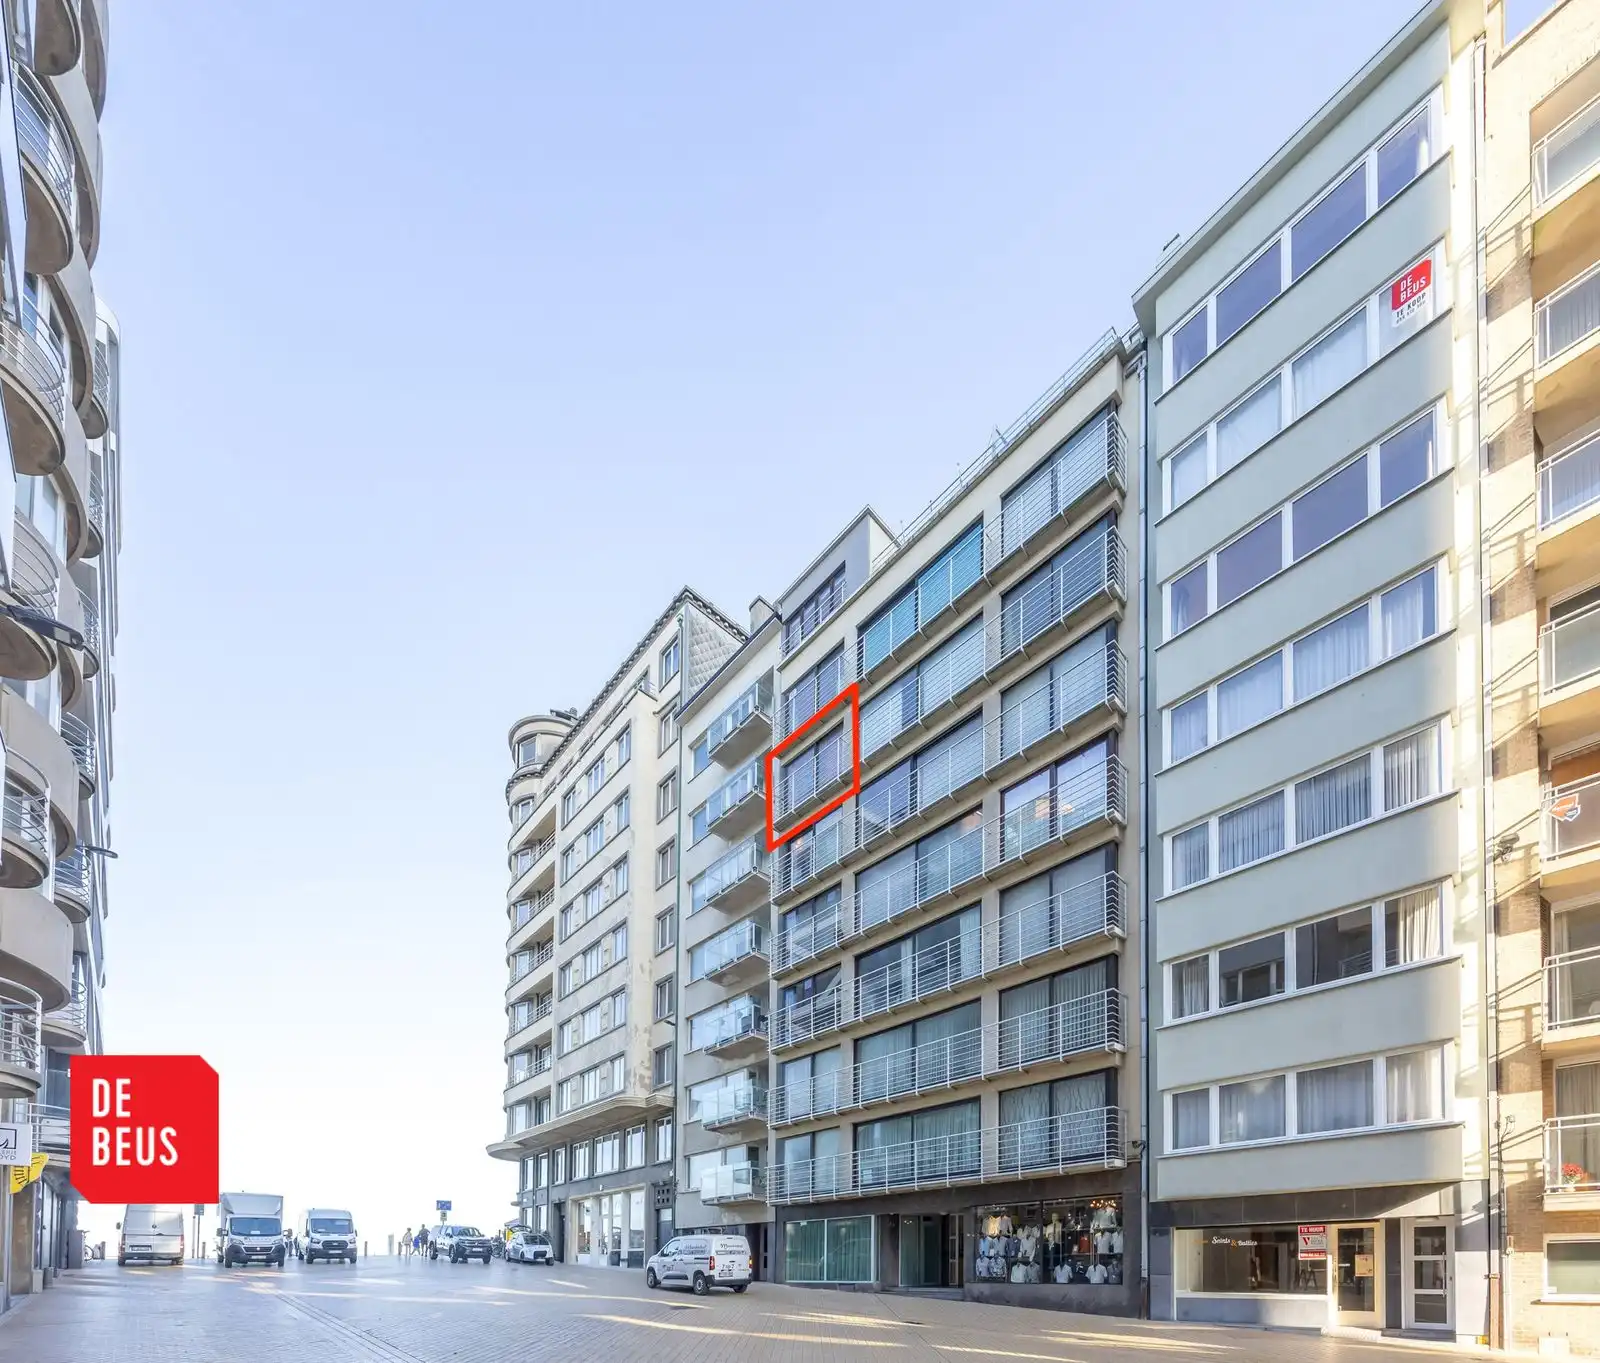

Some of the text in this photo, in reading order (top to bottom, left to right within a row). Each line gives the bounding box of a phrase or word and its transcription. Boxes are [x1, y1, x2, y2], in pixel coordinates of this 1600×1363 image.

[1400, 275, 1412, 291] DE
[1400, 276, 1426, 302] BEUS
[1396, 308, 1403, 317] TE
[1407, 292, 1426, 310] KOOP
